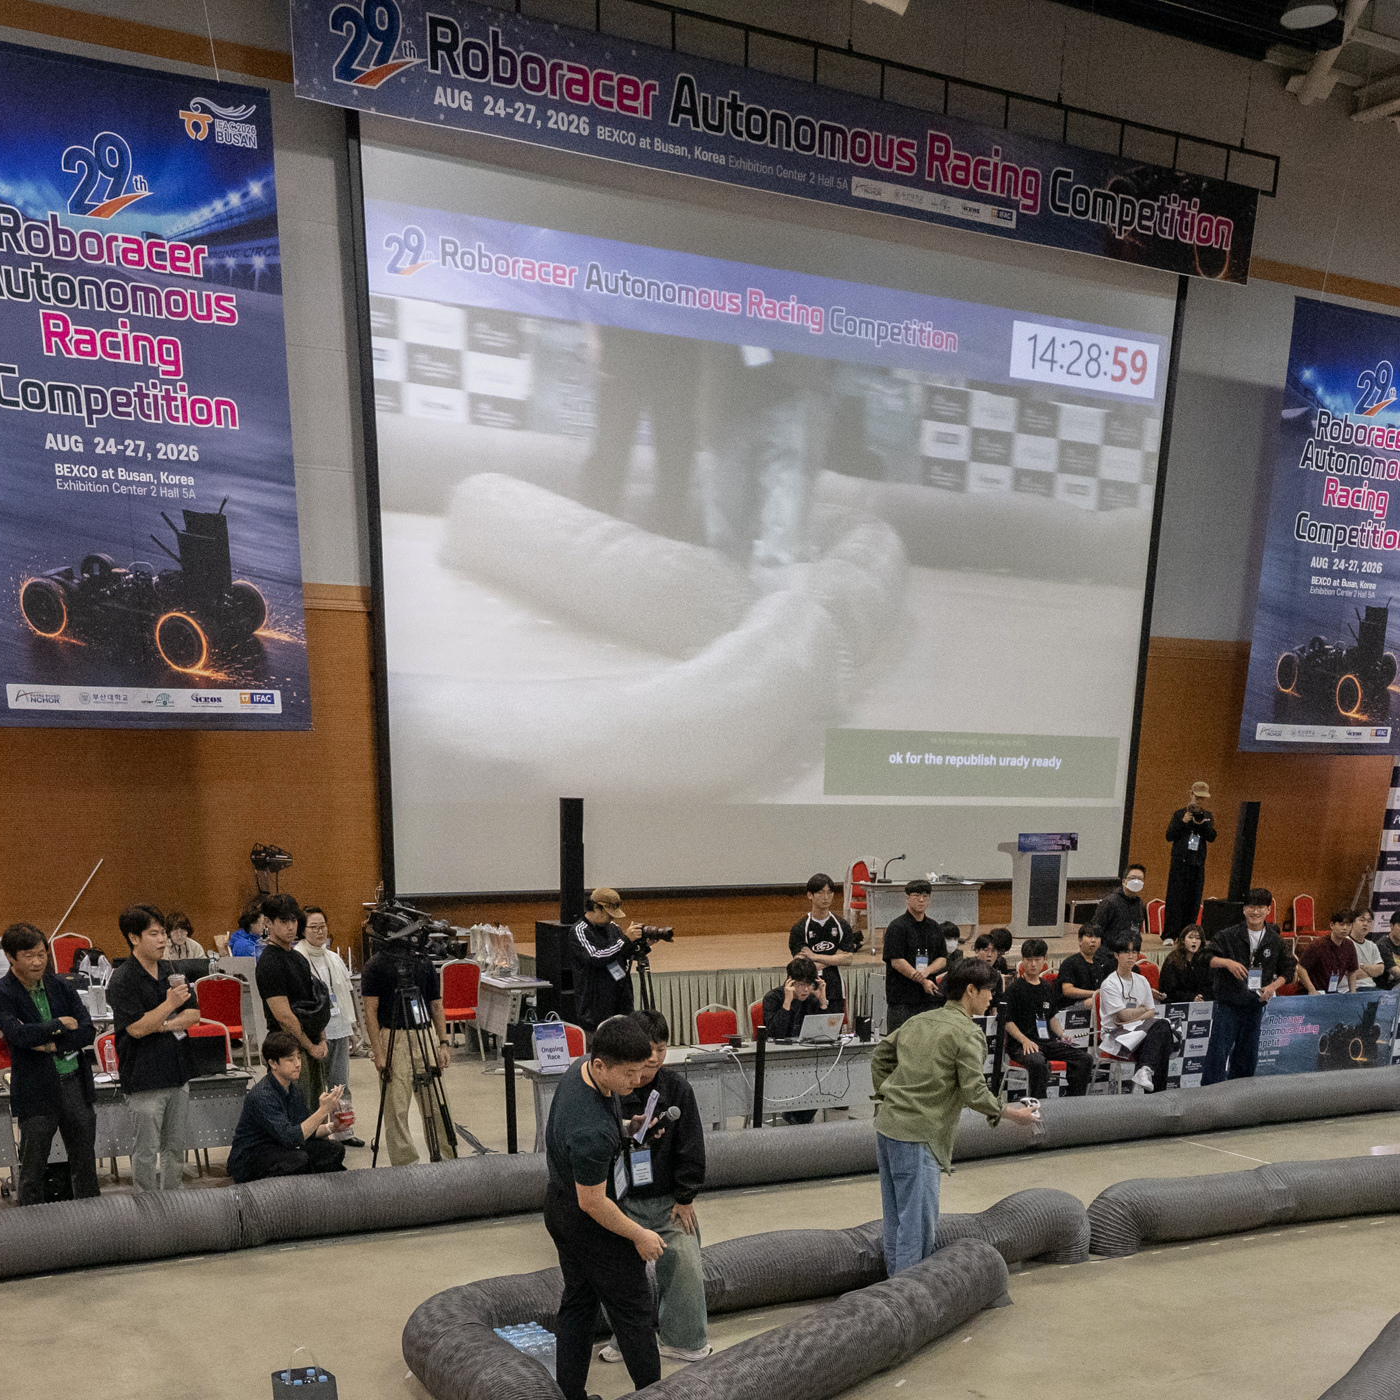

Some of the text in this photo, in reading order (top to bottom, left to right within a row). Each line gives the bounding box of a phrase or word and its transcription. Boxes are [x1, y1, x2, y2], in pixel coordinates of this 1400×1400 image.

[215, 131, 258, 149] BUSAN
[425, 13, 659, 118] Roboracer
[669, 73, 917, 176] Autonomous
[926, 130, 1041, 215] Racing
[1049, 167, 1234, 251] Competition
[433, 85, 849, 190] AUG 24-27, 2026 BEXCO at Busan, Korea Exhibition Center 2 Hall 5A
[439, 237, 579, 289] Roboracer
[584, 262, 744, 315] Autonomous
[747, 289, 824, 334] Racing
[830, 307, 958, 354] Competition
[39, 309, 183, 379] Racing
[1026, 333, 1148, 386] 14:28:59
[45, 433, 199, 462] AUG 24-27, 2026
[54, 463, 195, 486] BEXCO at Busan, Korea
[55, 478, 196, 499] Exhibition Center 2 Hall 5A
[1322, 476, 1389, 519] Racing
[1310, 556, 1383, 574] AUG 24-27, 2026
[1311, 576, 1332, 587] BEXCO
[1332, 578, 1340, 587] at
[253, 694, 273, 703] IFAC
[888, 751, 1062, 771] ok for the republish urady ready
[1269, 1014, 1305, 1025] Roboracer
[1294, 1024, 1320, 1035] Racing
